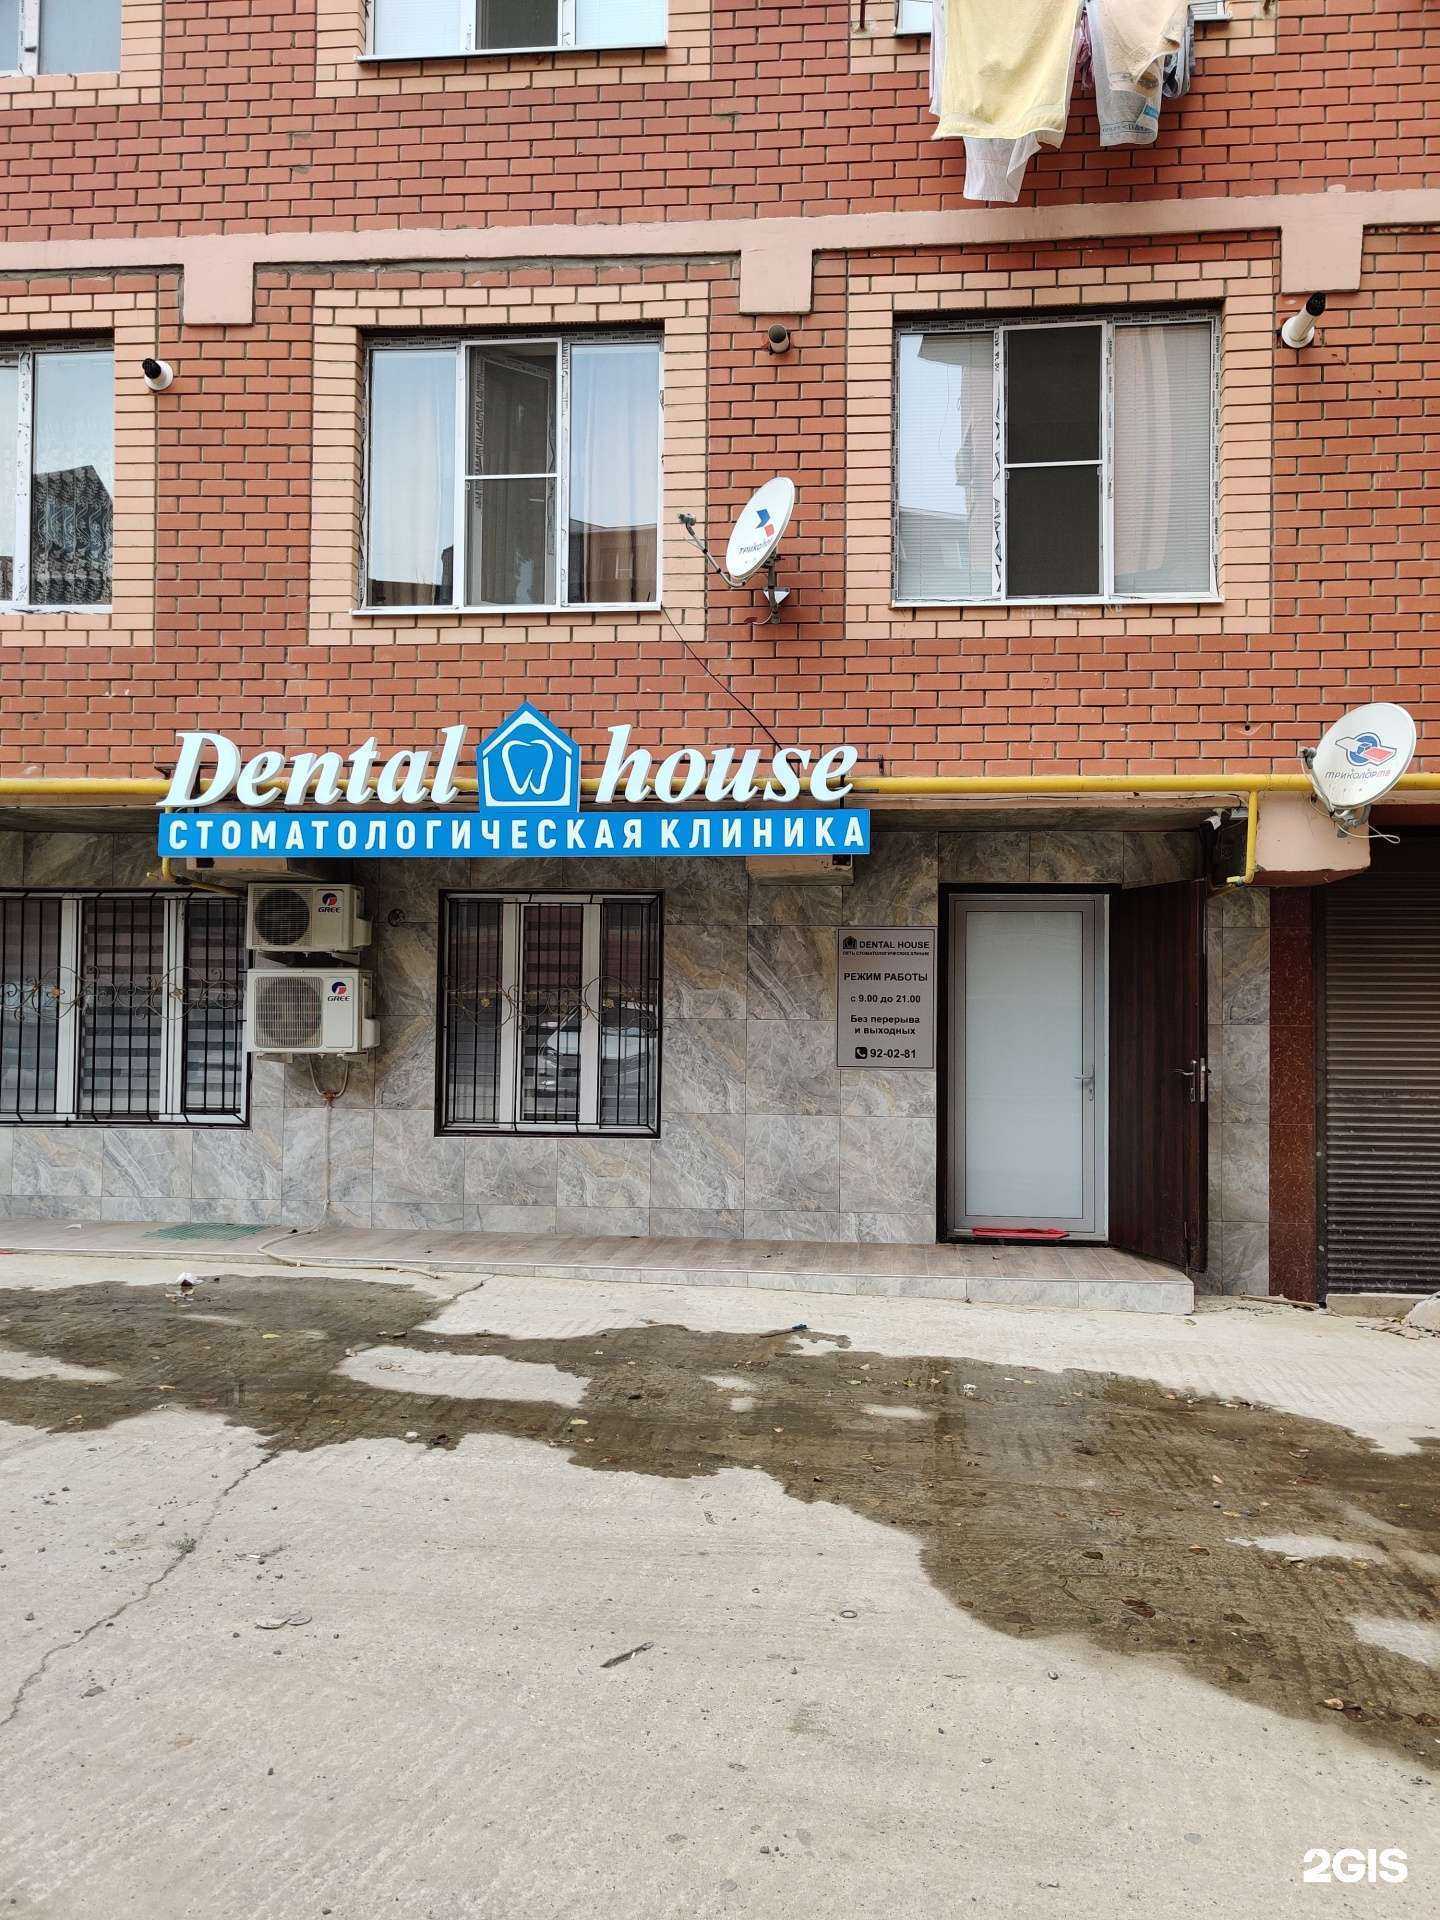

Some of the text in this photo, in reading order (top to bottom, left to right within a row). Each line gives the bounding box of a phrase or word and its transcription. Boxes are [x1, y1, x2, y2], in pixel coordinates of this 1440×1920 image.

[156, 724, 860, 807] Dental house
[168, 815, 865, 852] СТОМАТОЛОГИЧЕСКАЯ КЛИНИКА
[859, 941, 929, 949] DENTAL HOUSE
[843, 973, 928, 981] РЕЖИМ РАБОТЫ
[880, 996, 893, 1004] до
[896, 995, 921, 1003] 21.00
[850, 1015, 920, 1025] Без перерыва
[870, 1049, 916, 1058] 92-02-81
